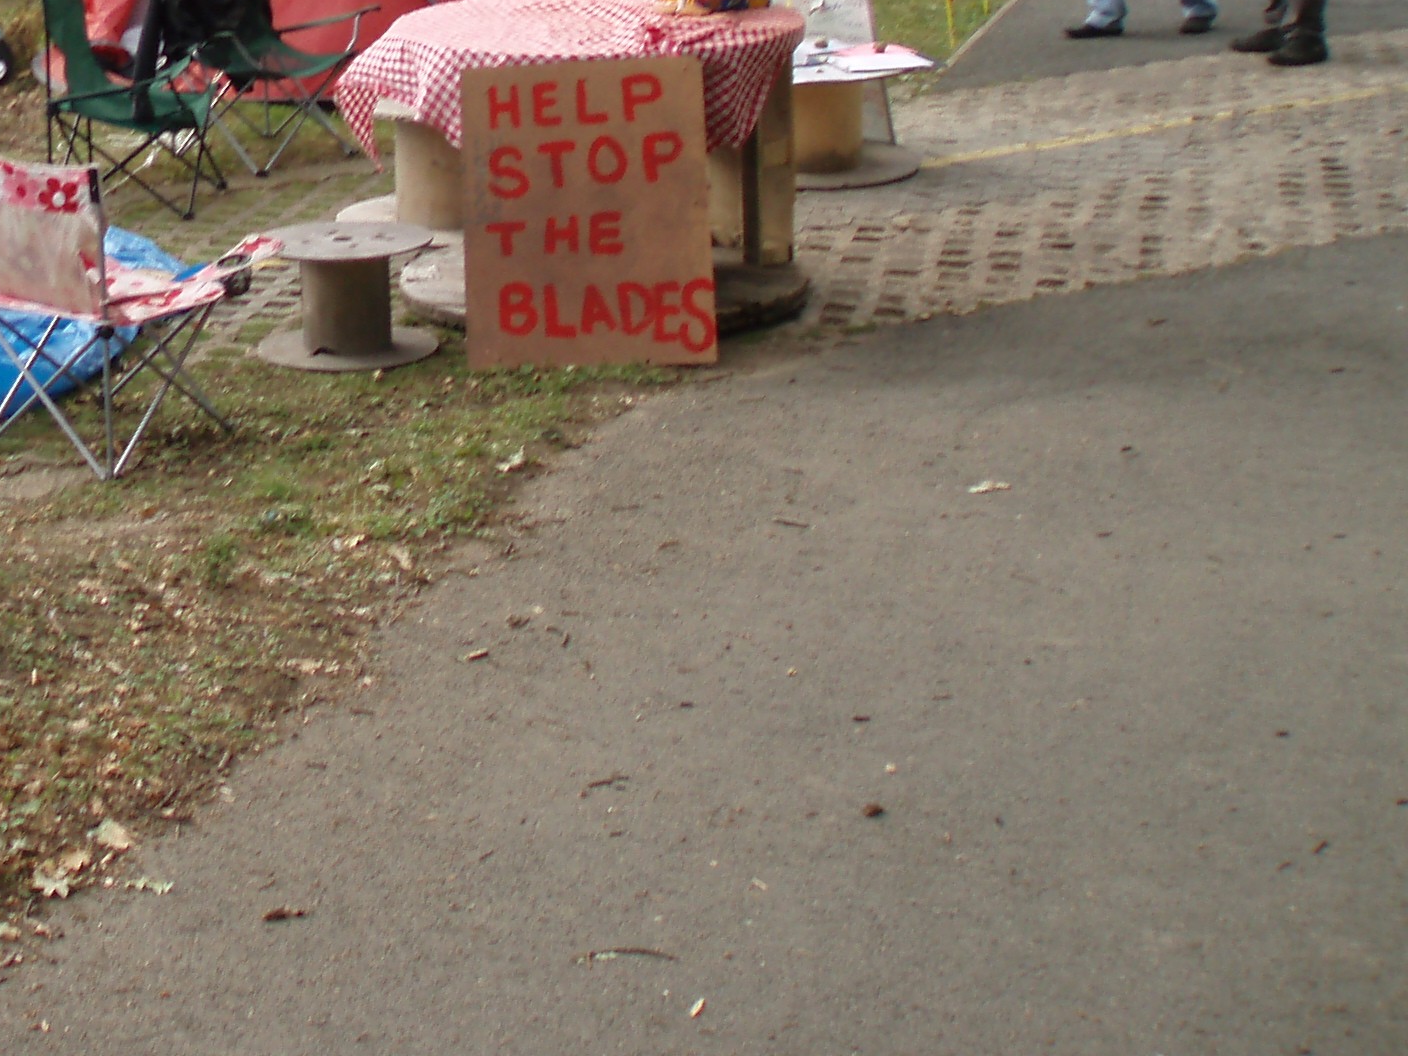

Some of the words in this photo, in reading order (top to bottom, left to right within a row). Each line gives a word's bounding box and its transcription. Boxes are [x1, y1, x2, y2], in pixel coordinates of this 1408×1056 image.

[487, 72, 663, 130] HELP
[487, 130, 683, 200] STOP
[485, 210, 624, 257] THE
[497, 276, 717, 354] BLADES
